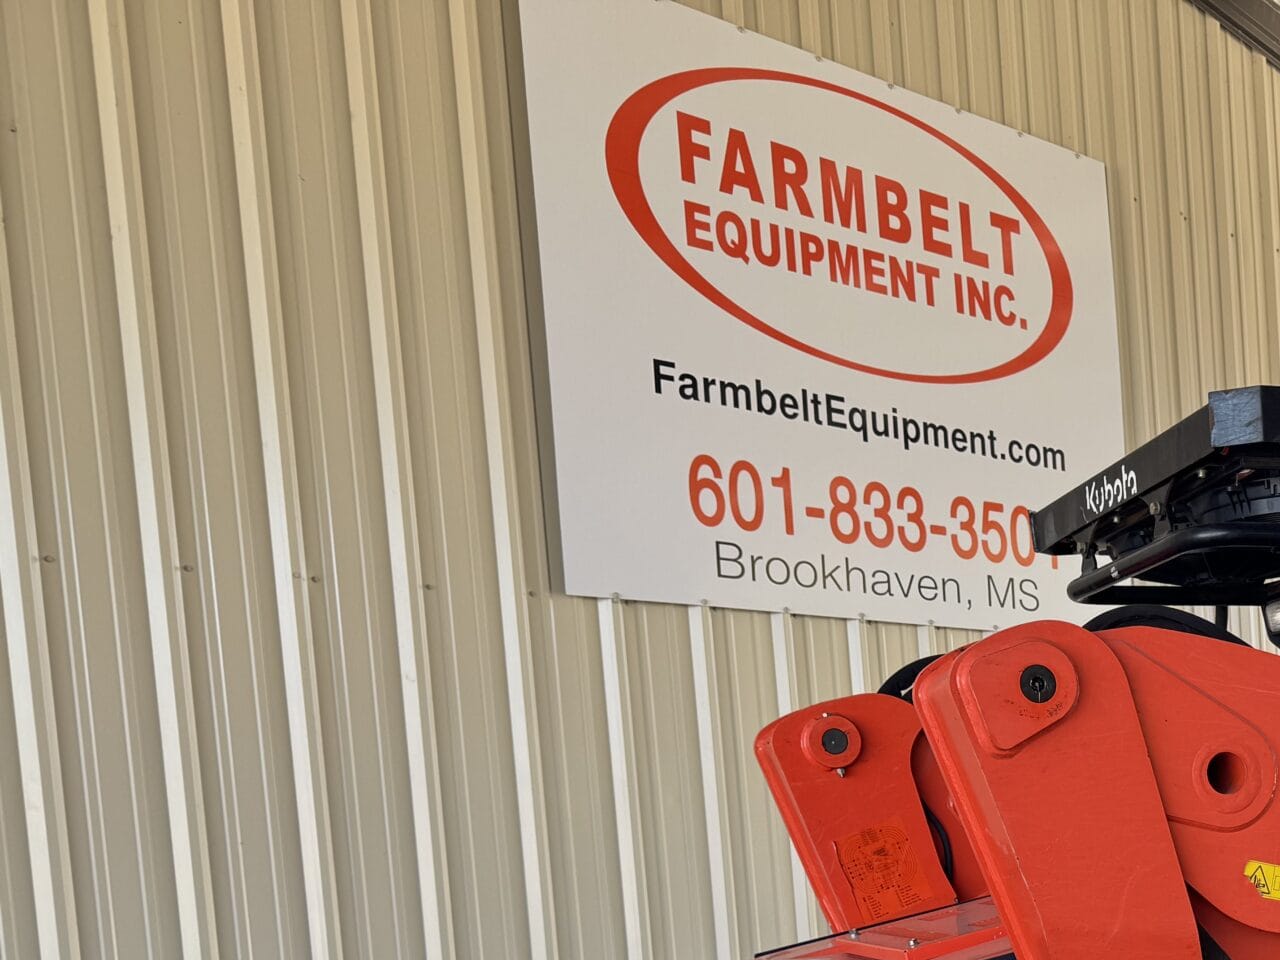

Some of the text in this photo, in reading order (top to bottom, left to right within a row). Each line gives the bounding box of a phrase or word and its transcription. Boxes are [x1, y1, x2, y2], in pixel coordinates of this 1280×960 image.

[676, 110, 1021, 276] FARMBELT
[683, 199, 1028, 331] EQUIPMENT INC.
[652, 358, 1066, 472] FarmbeltEquipment.com
[688, 454, 1059, 570] 601-833-350
[1085, 464, 1138, 515] Kubota
[714, 540, 1041, 612] Brookhaven, MS
